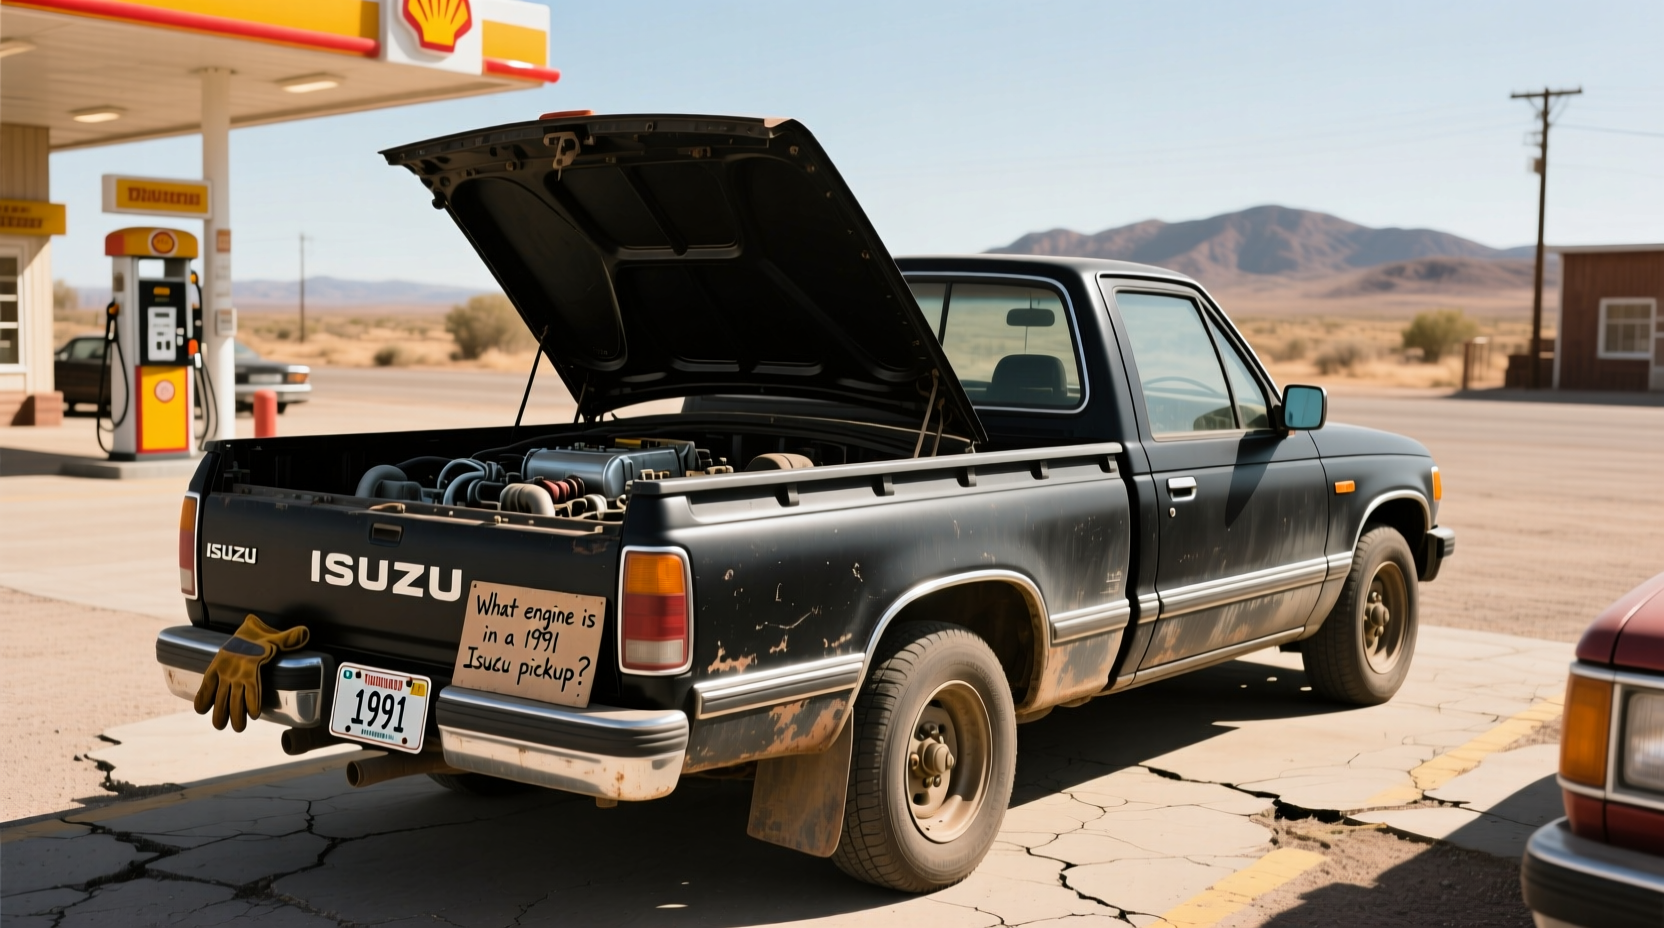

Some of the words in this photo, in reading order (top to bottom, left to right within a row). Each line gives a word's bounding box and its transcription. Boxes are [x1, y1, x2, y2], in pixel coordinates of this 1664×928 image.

[206, 542, 257, 564] ISUZU
[311, 550, 463, 602] ISUZU
[477, 591, 519, 618] What
[524, 605, 574, 631] engine
[582, 609, 596, 628] is
[482, 625, 498, 643] in
[504, 633, 515, 647] a
[524, 628, 559, 653] 1991
[516, 656, 591, 692] pickup?
[351, 689, 406, 733] 1991
